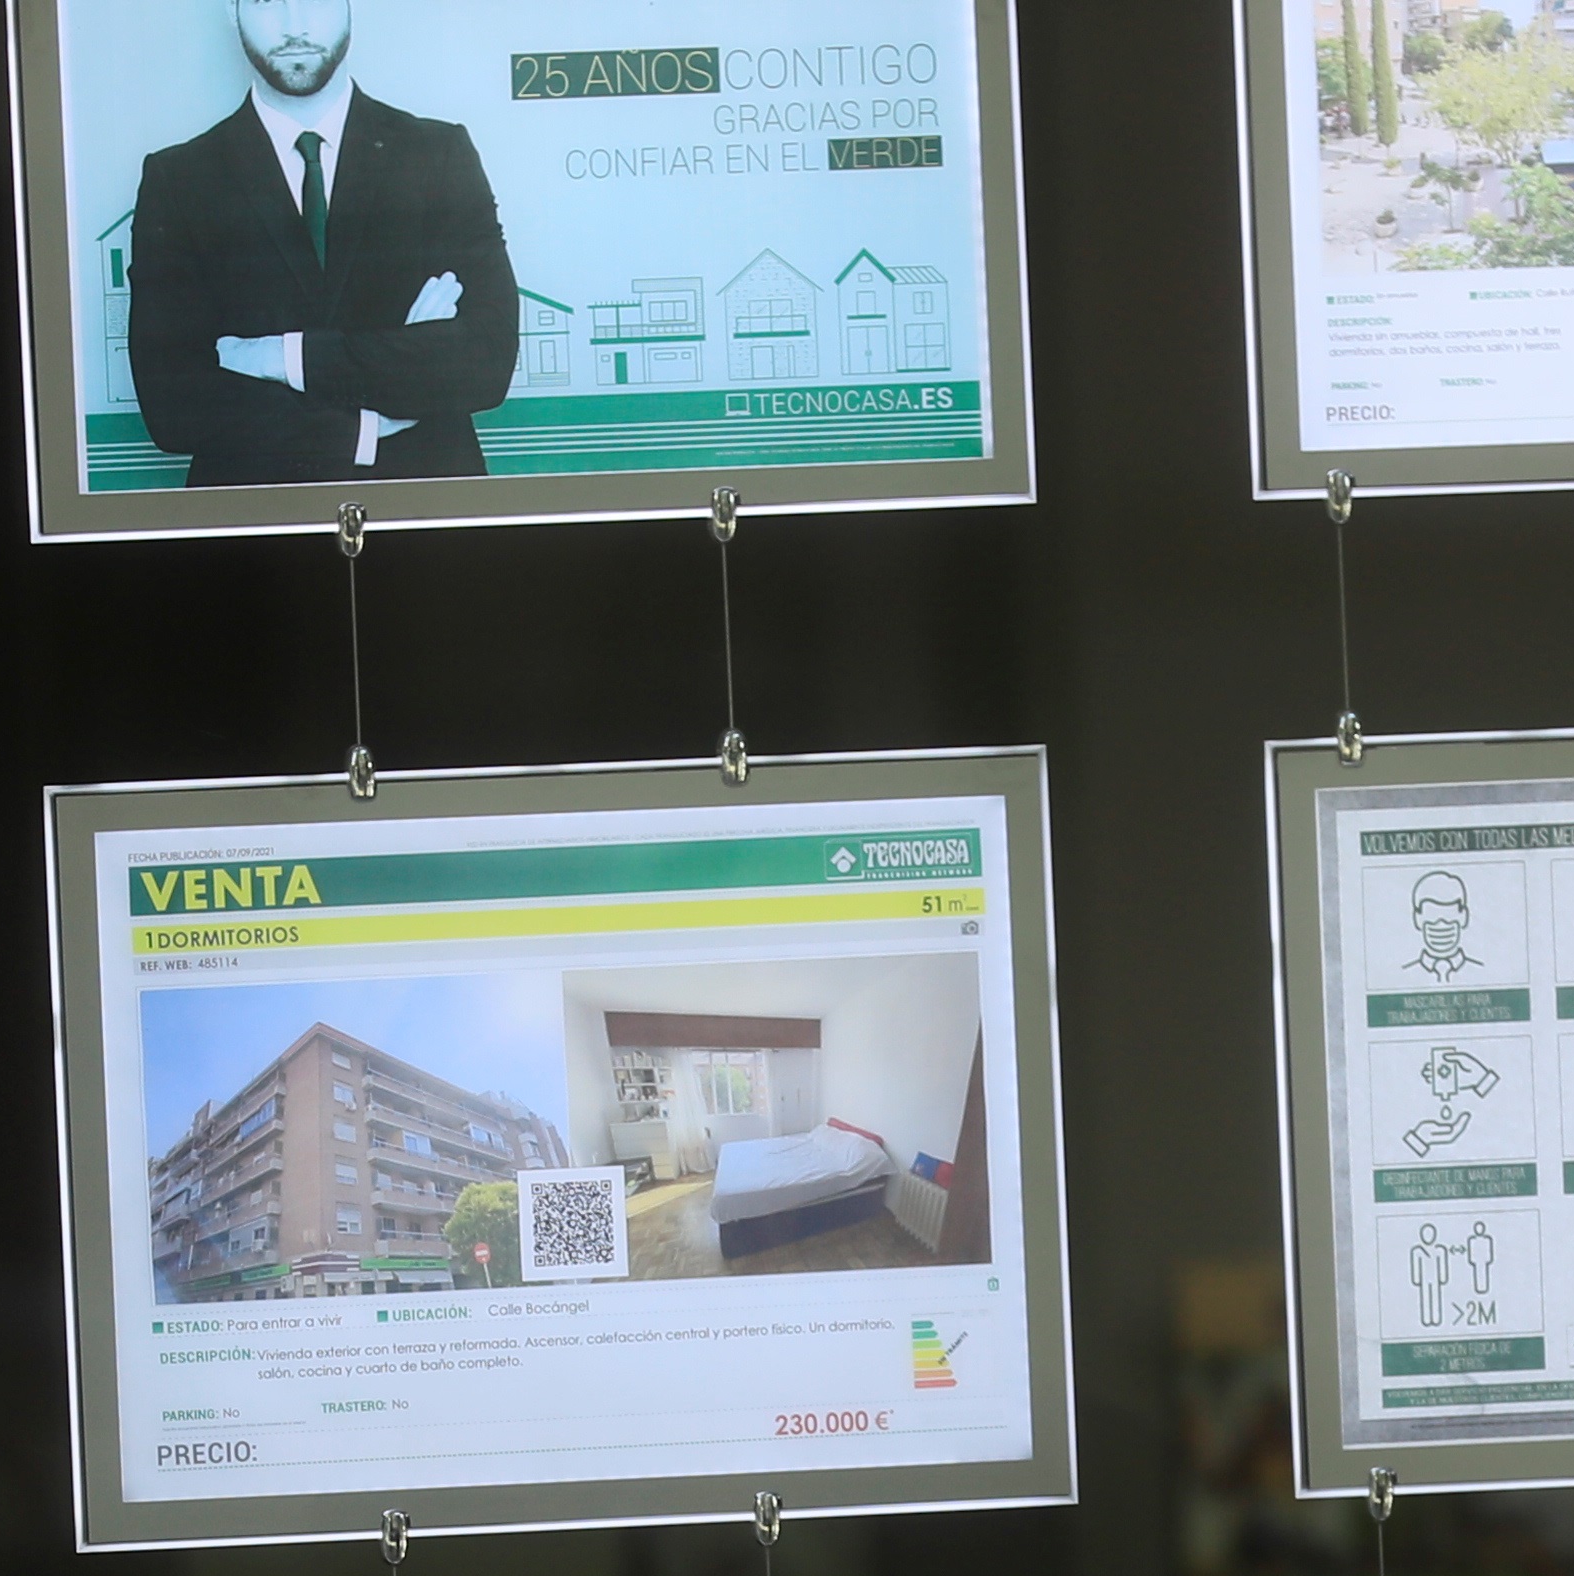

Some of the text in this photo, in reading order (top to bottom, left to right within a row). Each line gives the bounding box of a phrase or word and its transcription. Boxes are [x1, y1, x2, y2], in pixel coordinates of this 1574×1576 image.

[515, 43, 938, 98] 25 AÑOS CONTIGO
[714, 97, 939, 136] GRACIAS POR
[566, 136, 941, 179] CONFIAR EN EL VERDE
[755, 385, 953, 414] TECNOCASA.ES
[1326, 403, 1397, 421] PRECIO:
[862, 838, 969, 868] TECNOCASA
[140, 863, 323, 913] VENTA
[922, 896, 942, 913] 51
[141, 957, 239, 971] REF. WEB: 485114
[392, 1299, 591, 1321] UBICACIÓN: Calle Bocángel
[167, 1320, 224, 1334] ESTADO:
[227, 1318, 260, 1333] Para
[261, 1317, 301, 1328] entrar
[318, 1314, 343, 1326] vivir
[160, 1345, 256, 1363] DESCRIPCIÓN:
[257, 1347, 315, 1360] Vivienda
[314, 1345, 361, 1358] exterior
[364, 1346, 390, 1355] con
[391, 1342, 438, 1353] terraza
[447, 1338, 522, 1351] reformada.
[525, 1336, 585, 1346] Ascensor,
[586, 1329, 664, 1344] calefacción
[663, 1327, 712, 1340] central
[720, 1325, 770, 1338] portero
[769, 1323, 806, 1334] físico.
[808, 1322, 827, 1333] Un
[826, 1318, 896, 1332] dormitorio,
[257, 1366, 296, 1379] salón,
[298, 1364, 344, 1377] cocina
[356, 1361, 398, 1374] cuarto
[400, 1360, 419, 1372] de
[418, 1358, 455, 1371] baño
[457, 1355, 525, 1369] completo.
[162, 1408, 241, 1421] PARKING: No
[321, 1399, 410, 1413] TRASTERO: No
[775, 1411, 869, 1435] 230.000
[157, 1441, 258, 1466] PRECIO:
